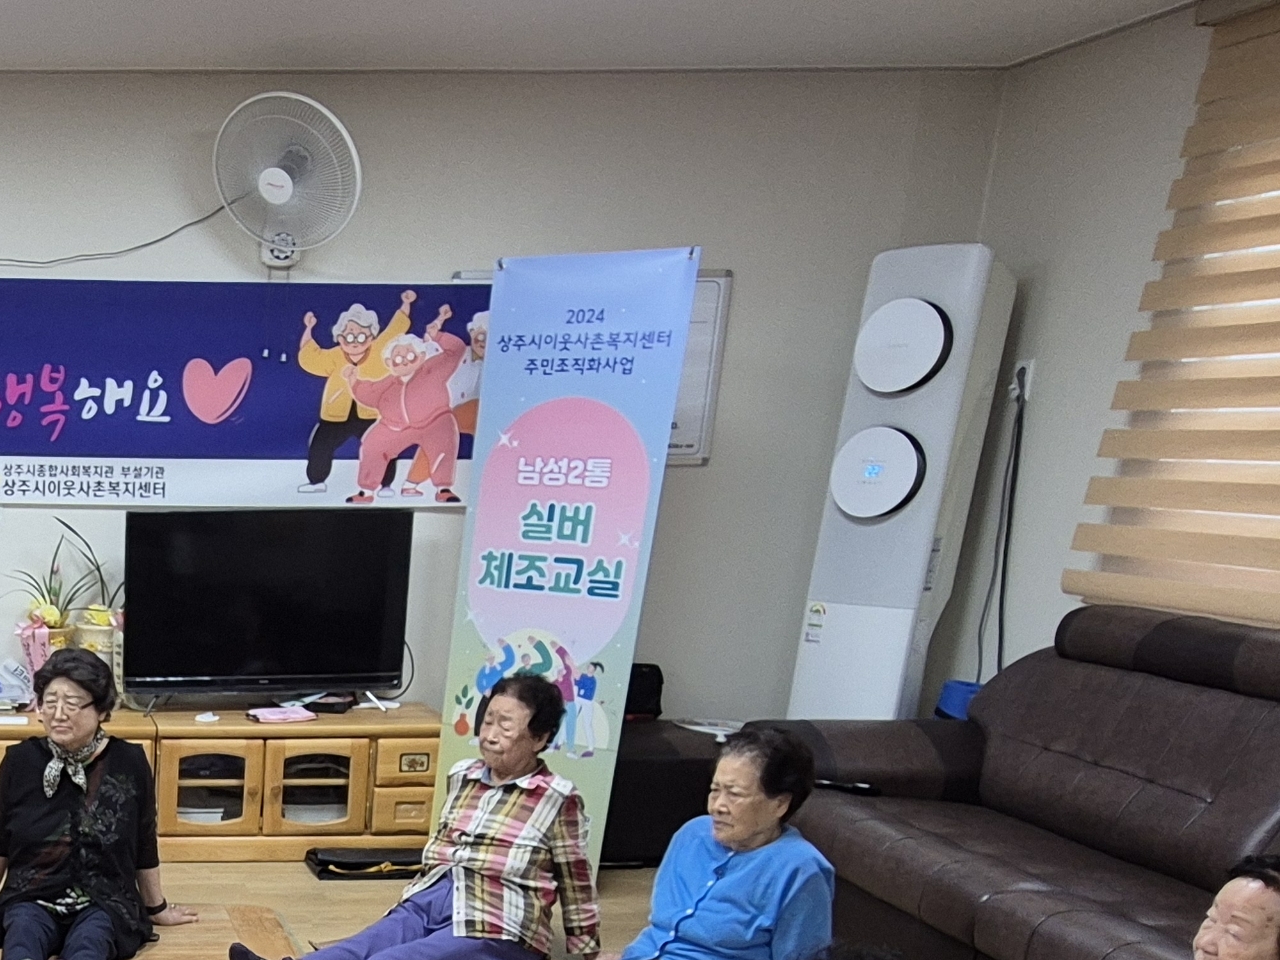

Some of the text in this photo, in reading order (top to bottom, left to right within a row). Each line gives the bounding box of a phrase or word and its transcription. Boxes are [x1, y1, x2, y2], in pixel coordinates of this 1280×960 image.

[565, 308, 606, 325] 2024
[496, 329, 673, 353] 상주시이웃사촌복지센터
[523, 355, 635, 377] 주민조직화사업
[2, 463, 165, 480] 상주시종합사회복지관 부설기관
[517, 456, 612, 488] 남성2통
[2, 479, 166, 499] 상주시이웃사촌복지센터
[520, 501, 594, 544] 실버
[478, 550, 624, 599] 체조교실
